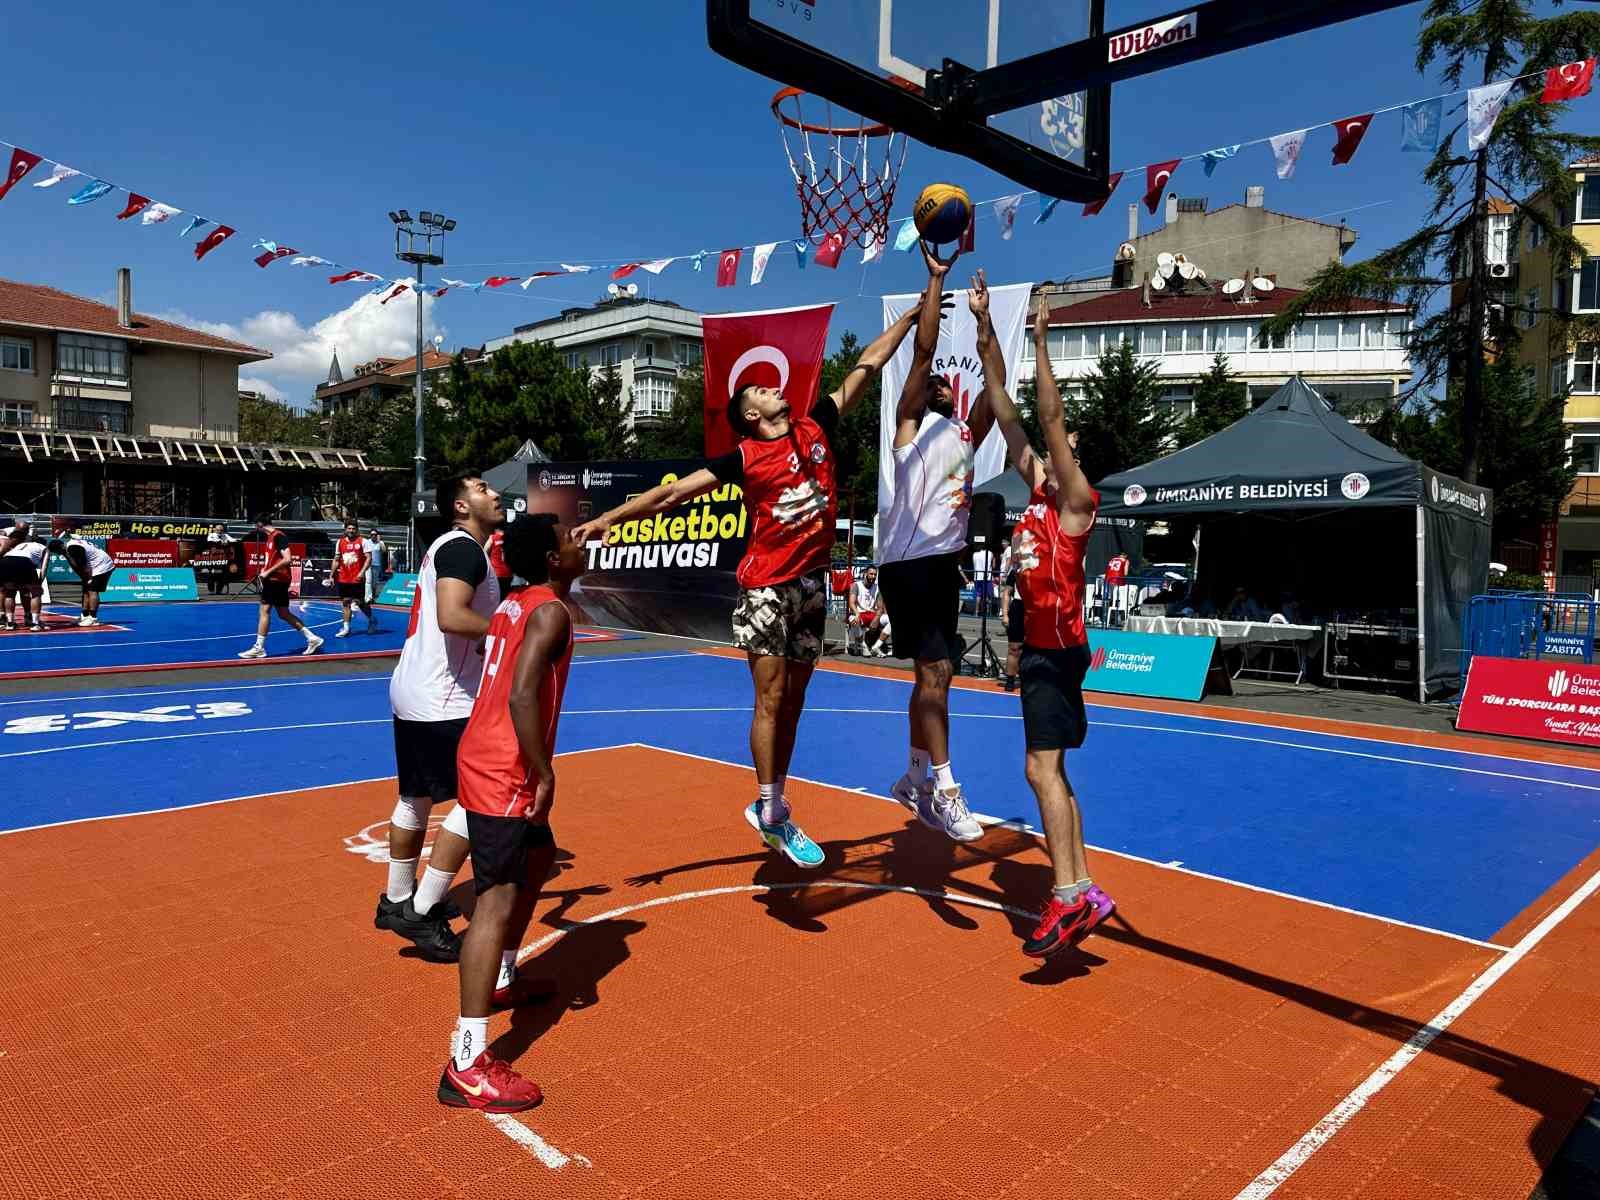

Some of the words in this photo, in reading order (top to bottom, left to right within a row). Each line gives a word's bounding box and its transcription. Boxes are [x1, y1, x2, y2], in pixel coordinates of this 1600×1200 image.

[1110, 23, 1193, 60] Wilson
[1155, 483, 1234, 502] ÜMRANİYE
[1240, 479, 1328, 499] BELEDİYESİ
[131, 522, 160, 538] Hoş
[585, 540, 720, 570] Turnuvası
[189, 559, 229, 567] Turnuvası
[1544, 636, 1585, 646] ÜMRANİYE
[1108, 649, 1156, 663] Ümraniye
[1544, 644, 1584, 656] ZABITA
[1106, 659, 1153, 673] Belediyesi
[1481, 694, 1505, 705] TÜM
[1506, 697, 1576, 713] SPORCULARA
